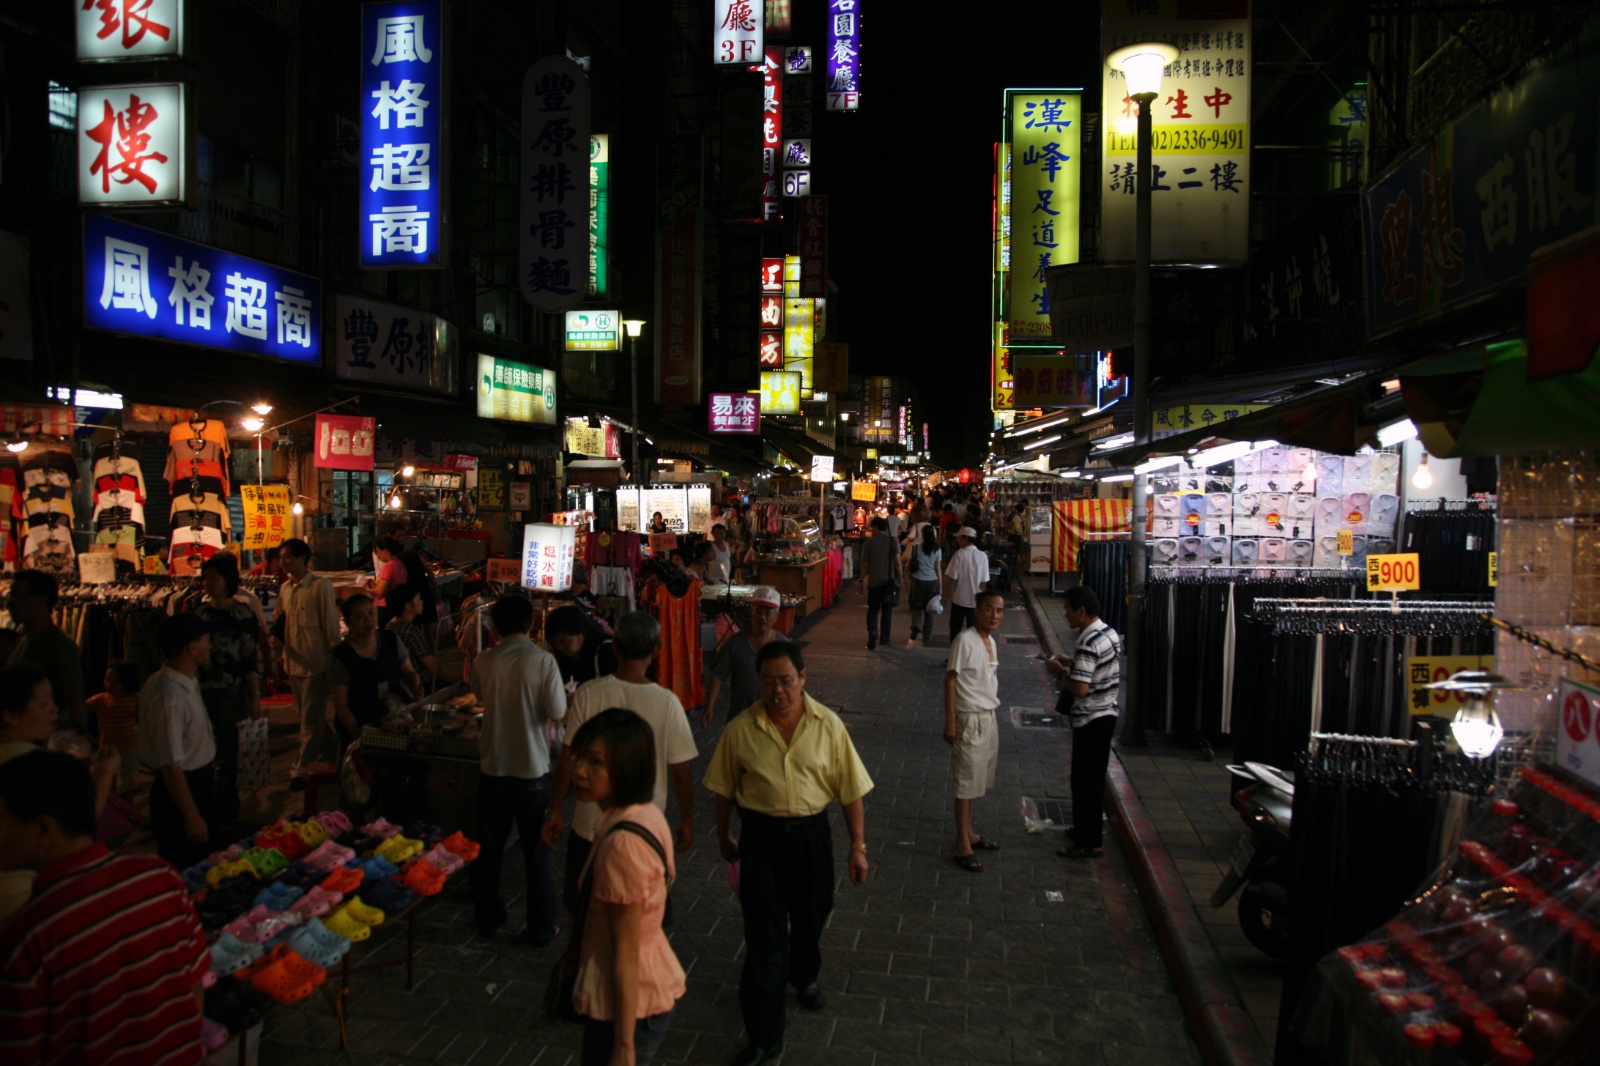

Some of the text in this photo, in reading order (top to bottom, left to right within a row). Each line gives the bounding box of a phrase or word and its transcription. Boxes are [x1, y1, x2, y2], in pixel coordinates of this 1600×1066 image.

[721, 40, 756, 62] 3F
[829, 93, 857, 109] 7F
[368, 14, 433, 257] 風格超商
[527, 72, 578, 296] 豐原排骨麵
[784, 172, 807, 196] 6F
[1109, 161, 1244, 195] 請上二樓
[99, 235, 312, 348] 風格超商
[711, 395, 755, 416] 易來
[713, 416, 755, 427] 餐廳2F
[320, 421, 373, 461] 100
[1381, 560, 1416, 585] 900
